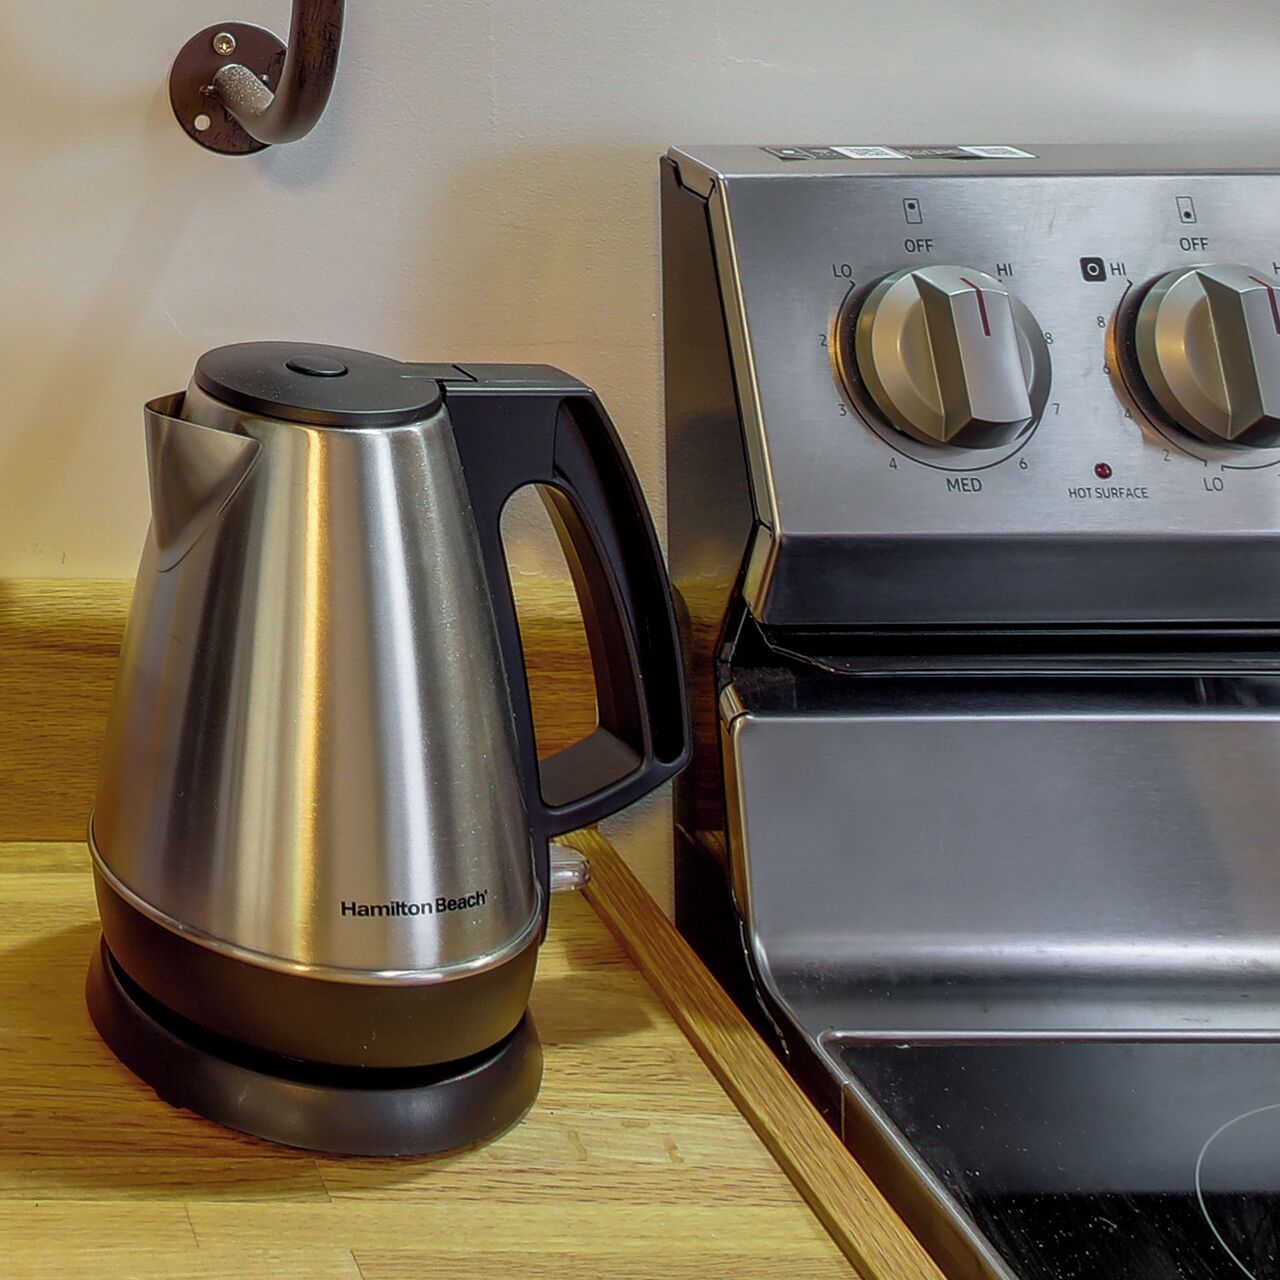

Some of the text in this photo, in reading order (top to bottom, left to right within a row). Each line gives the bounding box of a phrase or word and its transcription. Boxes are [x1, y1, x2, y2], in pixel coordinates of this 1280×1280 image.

[903, 238, 934, 253] OFF
[1179, 237, 1209, 252] OFF
[832, 263, 853, 280] LO
[996, 263, 1013, 277] HI
[1109, 262, 1127, 277] HI
[1097, 315, 1106, 329] 8
[819, 333, 828, 347] 2
[1044, 331, 1054, 346] 8
[838, 403, 848, 417] 3
[1052, 402, 1061, 416] 7
[1123, 407, 1133, 421] 4
[1162, 447, 1171, 462] 2
[888, 456, 899, 471] 4
[1019, 456, 1029, 471] 6
[946, 477, 983, 493] MED
[1203, 476, 1224, 492] LO
[1068, 487, 1149, 500] HOT SURFACE
[340, 890, 486, 917] Hamilton Beach
